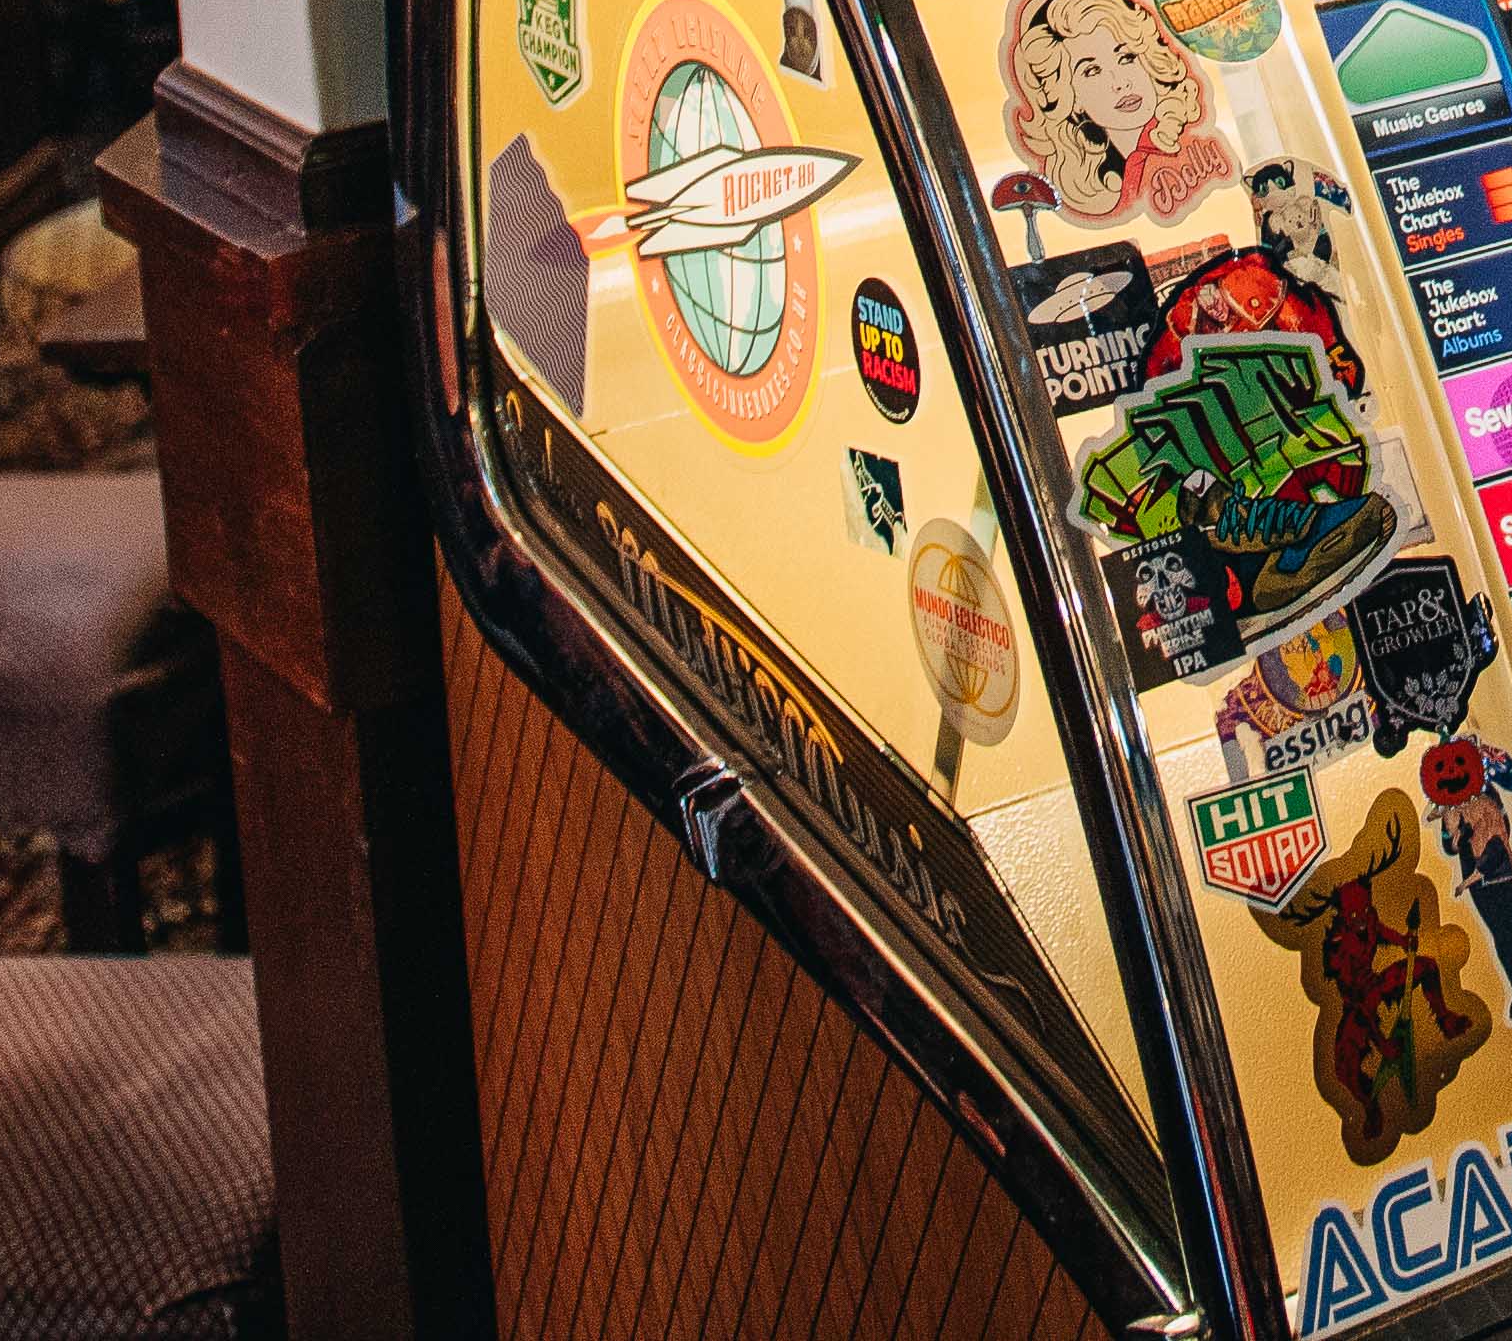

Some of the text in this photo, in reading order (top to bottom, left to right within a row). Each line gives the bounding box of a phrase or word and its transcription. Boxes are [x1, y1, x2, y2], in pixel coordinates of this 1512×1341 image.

[534, 13, 566, 41] KEG
[522, 28, 579, 73] CHAMPION
[1372, 99, 1486, 138] Music Genres
[722, 162, 815, 217] ROCKET-88
[1151, 140, 1228, 214] Dolly
[1386, 175, 1420, 197] The
[1395, 183, 1464, 214] Jukebox
[1399, 208, 1452, 233] Chart:
[1406, 226, 1465, 253] Singles
[1420, 279, 1454, 300] The
[1429, 286, 1498, 318] Jukebox
[857, 296, 903, 334] STAND
[1433, 311, 1486, 337] Chart:
[860, 323, 903, 360] UP TO
[1036, 323, 1151, 377] TURNING
[1442, 326, 1503, 358] Albums
[863, 354, 917, 396] RACISM
[1045, 364, 1128, 405] POINT
[1122, 533, 1183, 561] DEFTONES
[915, 586, 952, 623] MUNDO
[1372, 616, 1459, 658] GROWLER
[1173, 653, 1207, 677] IPA
[1212, 781, 1295, 839] HIT
[1209, 823, 1315, 893] SQUAD
